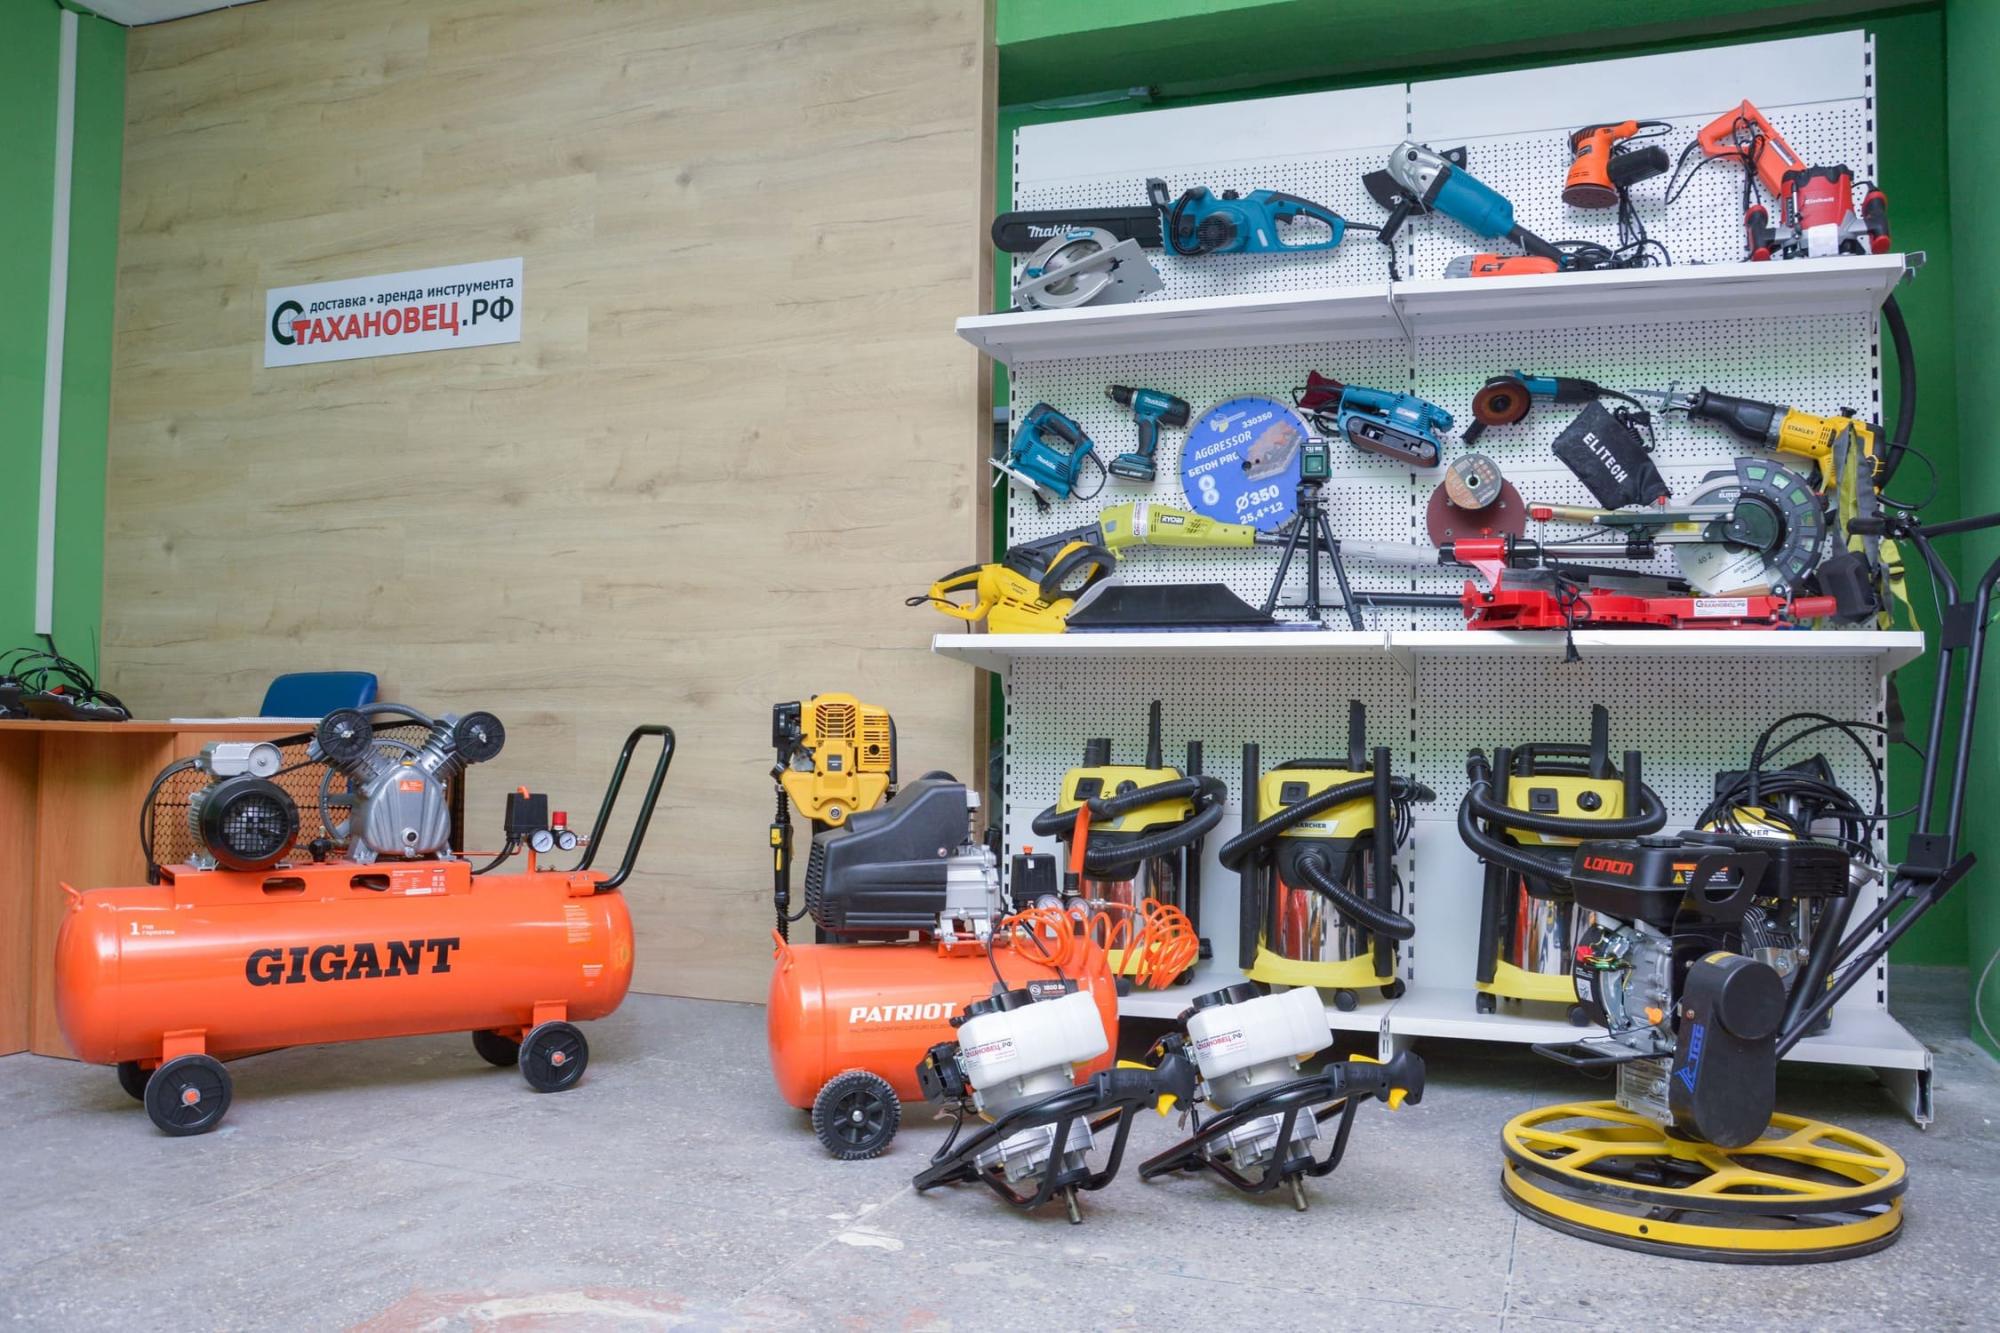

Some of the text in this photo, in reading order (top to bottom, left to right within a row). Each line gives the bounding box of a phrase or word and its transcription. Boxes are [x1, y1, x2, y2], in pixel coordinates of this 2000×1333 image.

[309, 277, 514, 314] доставка аренда инструмента
[1241, 411, 1273, 429] 330350
[1195, 430, 1252, 461] AGGRESSOR
[1582, 432, 1628, 484] ELITECH
[1188, 458, 1219, 478] БЕТОН
[245, 937, 460, 987] GIGANT
[848, 1002, 957, 1024] PATRIOT
